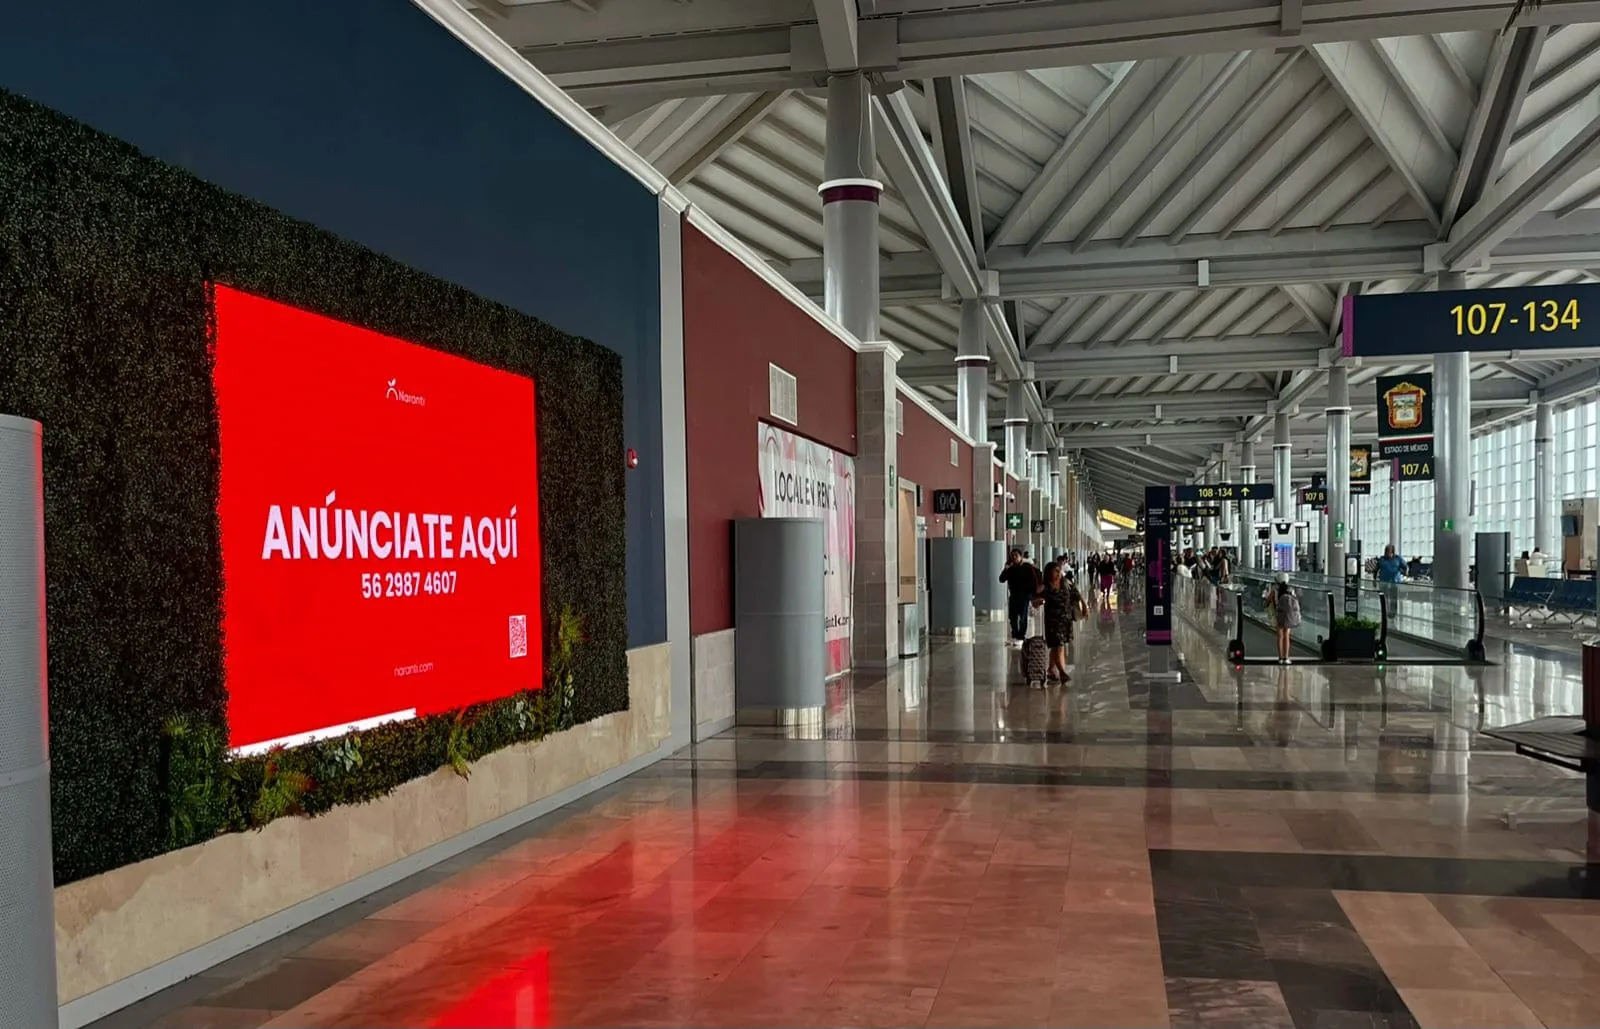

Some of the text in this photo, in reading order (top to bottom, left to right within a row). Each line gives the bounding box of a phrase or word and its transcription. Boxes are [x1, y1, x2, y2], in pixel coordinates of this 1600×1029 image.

[1450, 299, 1581, 336] 107-134
[1401, 463, 1430, 476] 107 A
[774, 470, 804, 505] LOCAL
[1305, 492, 1317, 501] 107
[261, 489, 518, 564] ANÚNCIATE AQUÍ
[361, 570, 457, 599] 56 2987 4607
